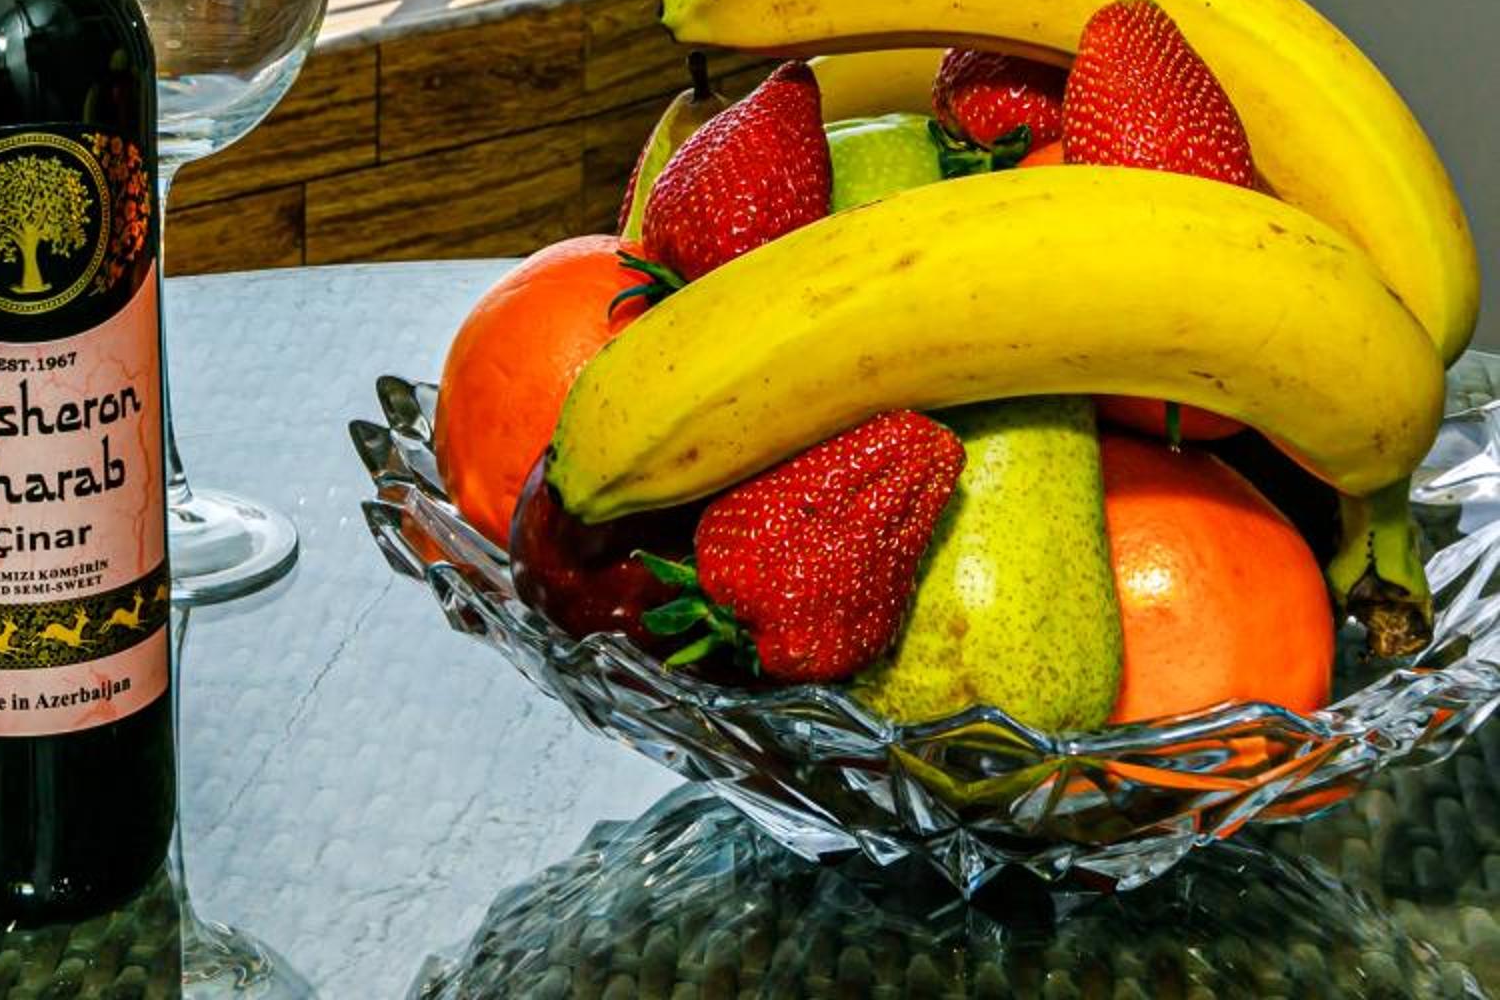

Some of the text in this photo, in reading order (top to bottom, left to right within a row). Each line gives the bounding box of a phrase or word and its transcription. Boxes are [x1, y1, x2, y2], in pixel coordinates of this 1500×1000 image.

[14, 574, 103, 596] SEMI-SWEET
[11, 693, 30, 711] in
[35, 677, 132, 709] Azerbaijan
